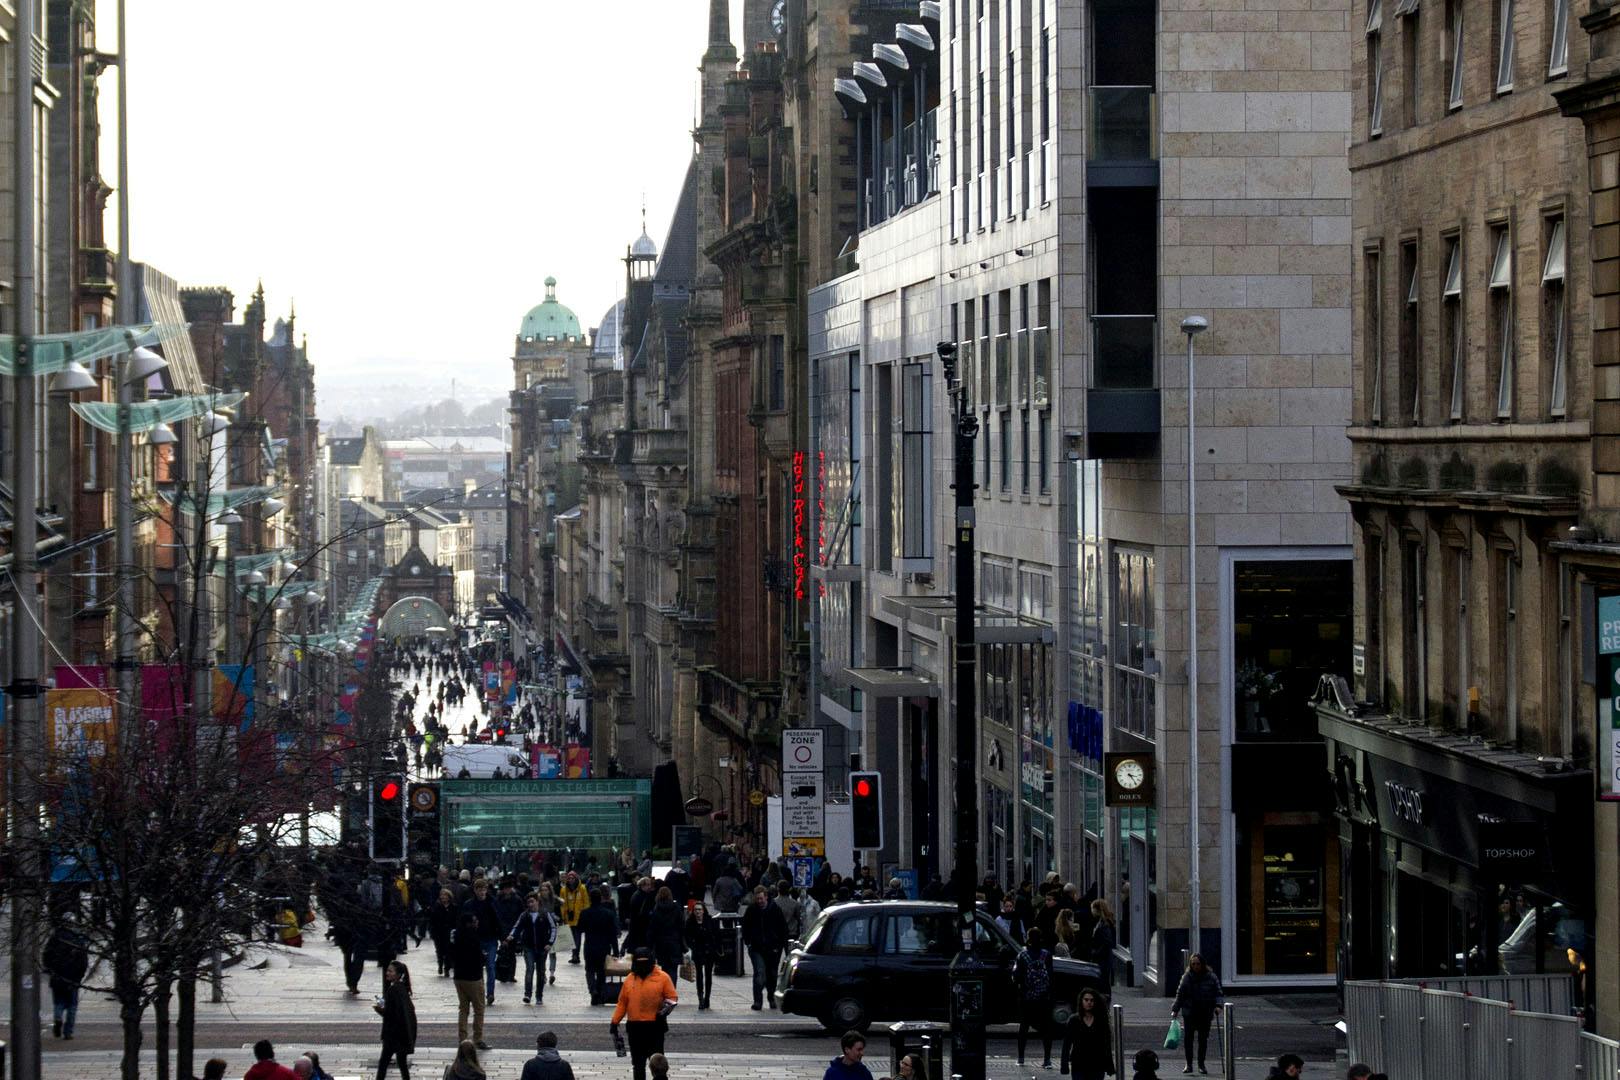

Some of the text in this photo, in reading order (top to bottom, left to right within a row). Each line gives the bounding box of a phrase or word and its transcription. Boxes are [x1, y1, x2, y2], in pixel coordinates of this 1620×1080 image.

[794, 451, 804, 493] Hard
[794, 499, 804, 549] Rock
[556, 783, 612, 793] STREET
[1486, 849, 1535, 858] TOPSHOP
